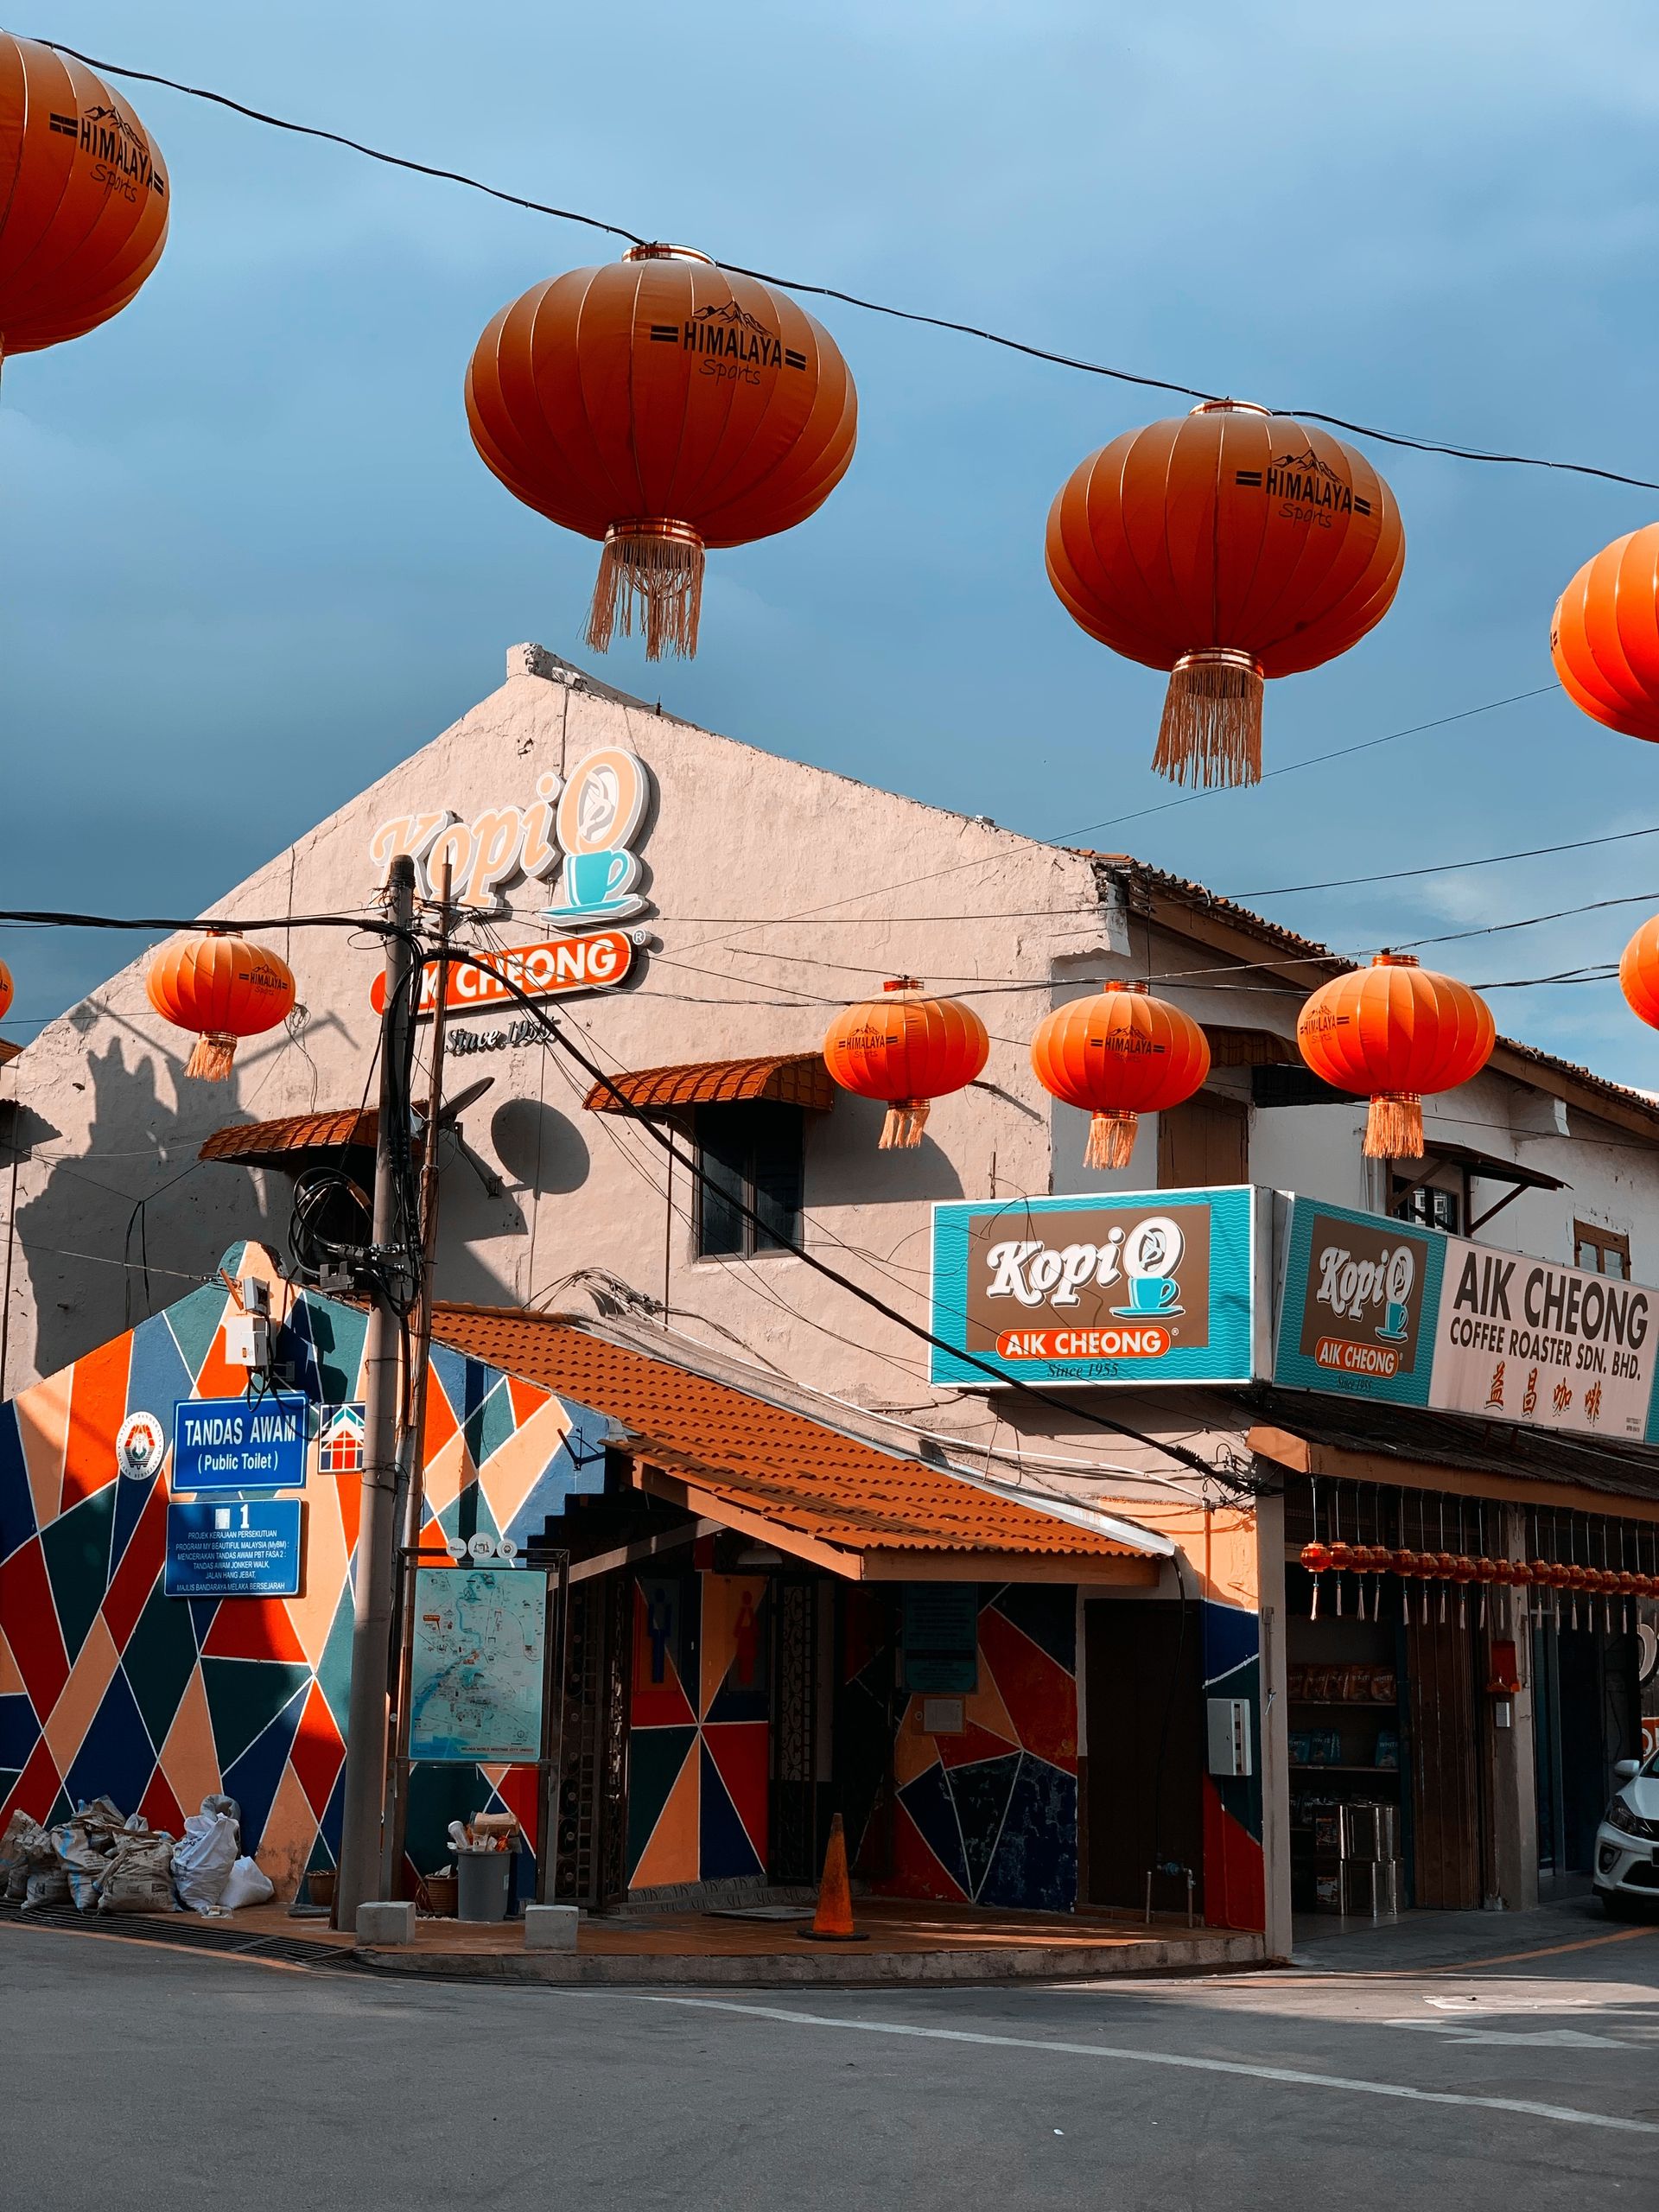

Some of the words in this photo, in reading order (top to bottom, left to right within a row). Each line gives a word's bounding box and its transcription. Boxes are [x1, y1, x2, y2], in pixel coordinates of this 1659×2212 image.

[79, 118, 154, 191] HIMALAYA
[91, 164, 137, 203] Sports
[683, 321, 782, 369] HIMALAYA
[699, 359, 760, 386] Sports
[1265, 467, 1352, 514] HIMALAYA
[1279, 503, 1332, 529] Sports
[251, 972, 282, 990] HIMALAYA
[456, 938, 618, 998] CHEONG
[446, 1027, 499, 1052] Since
[847, 1035, 885, 1050] HIMALAYA
[1105, 1036, 1152, 1054] HIMALAYA
[1452, 1250, 1516, 1321] AIK
[1523, 1267, 1649, 1351] CHEONG
[1005, 1333, 1046, 1356] AIK
[1055, 1330, 1161, 1355] CHEONG
[1319, 1341, 1343, 1365] AIK
[1344, 1345, 1395, 1374] CHEONG
[1450, 1316, 1505, 1353] COFFEE
[1509, 1328, 1573, 1367] ROASTER
[1575, 1344, 1607, 1375] SDN.
[1611, 1351, 1641, 1381] BHD.
[1047, 1363, 1084, 1378] Since
[1087, 1363, 1120, 1377] 1955
[185, 1417, 243, 1446] TANDAS
[250, 1415, 296, 1443] AWAM
[240, 1504, 250, 1529] 1
